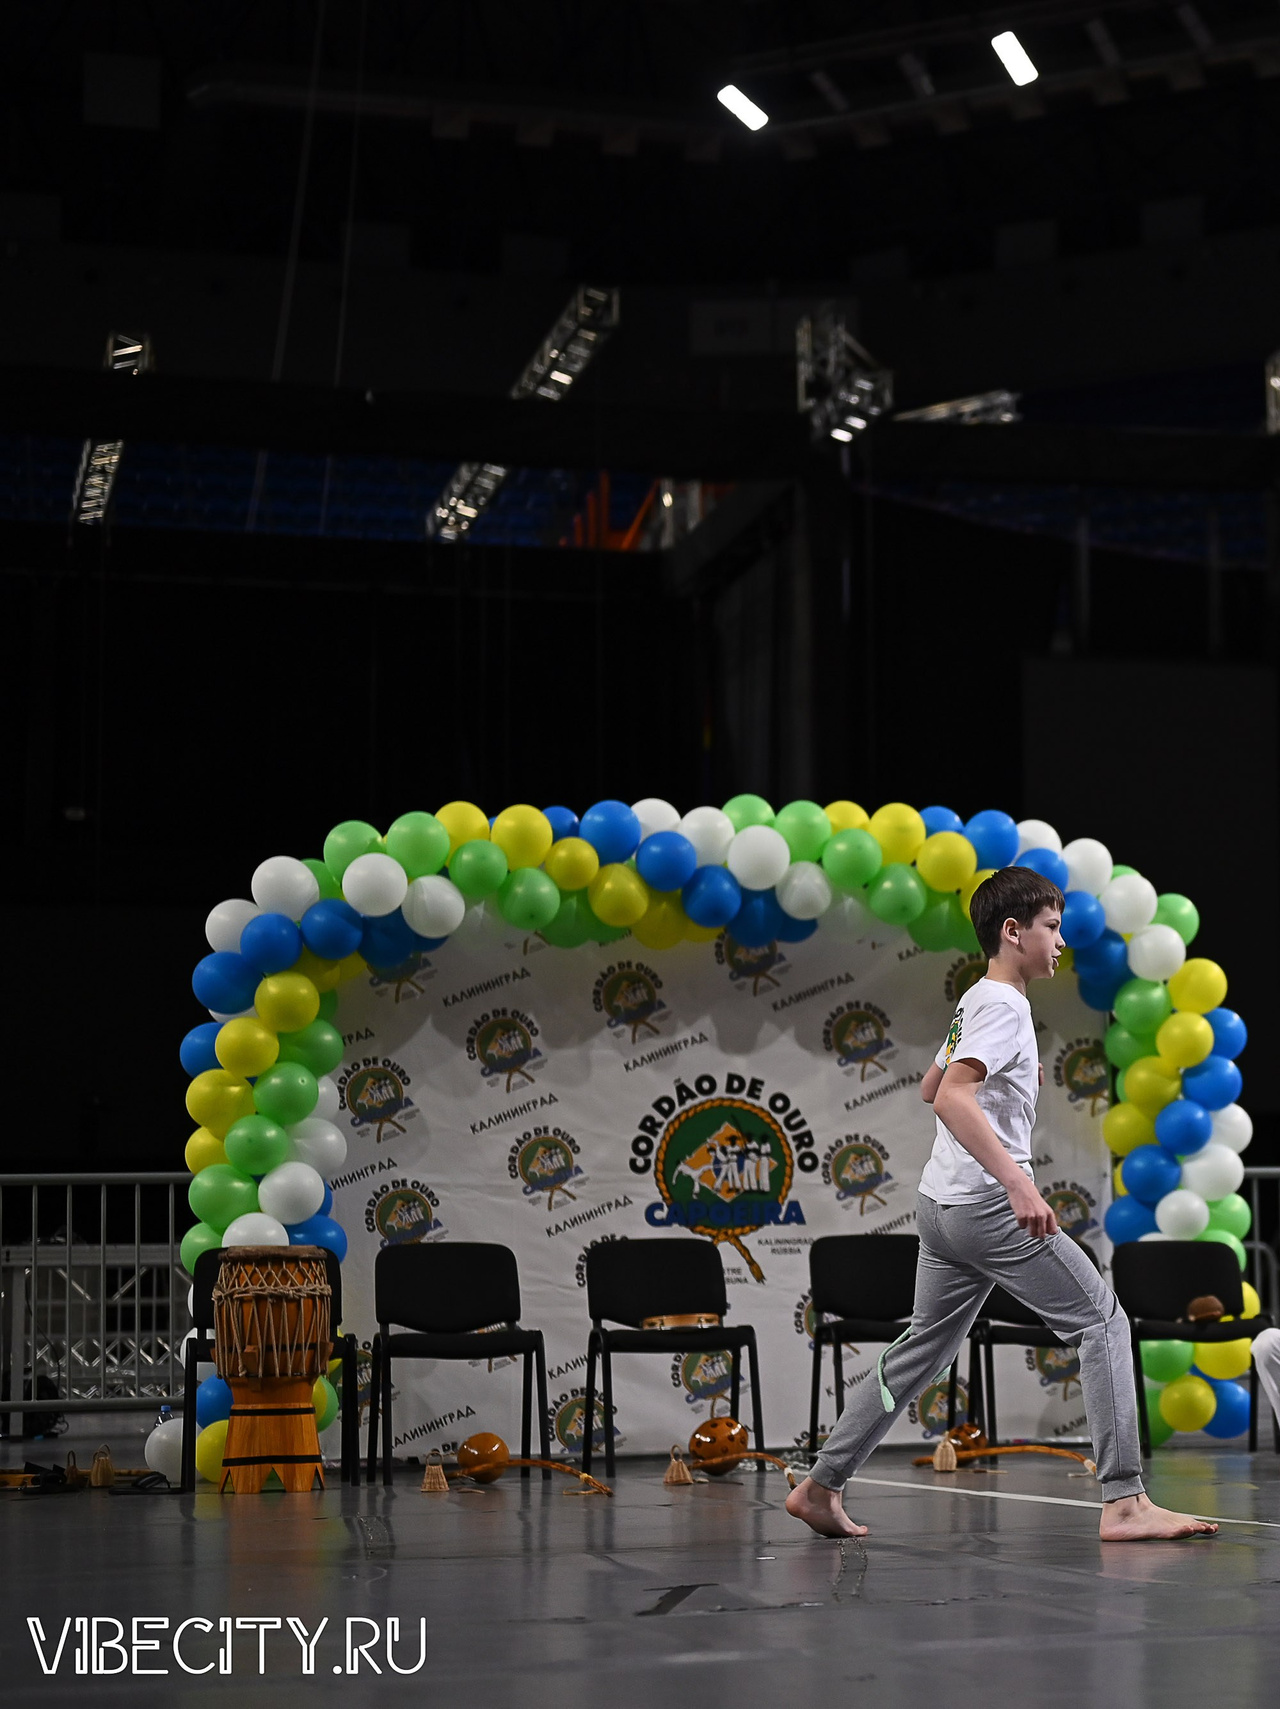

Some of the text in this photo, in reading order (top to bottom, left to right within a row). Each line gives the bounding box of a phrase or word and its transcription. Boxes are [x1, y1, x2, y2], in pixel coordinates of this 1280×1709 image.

[442, 967, 532, 1008] КАЛИНИНГРАД
[491, 1007, 508, 1018] DE
[510, 1008, 539, 1037] OURO
[623, 1032, 709, 1072] КАЛИНИНГРАД
[361, 1056, 378, 1067] DE
[382, 1058, 411, 1087] OURO
[469, 1092, 559, 1135] КАЛИНИНГРАД
[629, 1073, 717, 1175] CORDÃO
[725, 1072, 765, 1100] DE
[768, 1092, 819, 1174] OURO
[533, 1125, 549, 1137] DE
[552, 1126, 581, 1155] OURO
[330, 1157, 398, 1192] ИНИНГРАД
[391, 1179, 408, 1190] DE
[411, 1180, 440, 1208] OURO
[545, 1194, 634, 1238] КАЛИНИНГРАД
[644, 1200, 807, 1227] CAPOEIRA
[865, 1211, 917, 1235] ИНИНГР
[771, 1247, 802, 1255] RUSSIA
[670, 1352, 686, 1388] CORD
